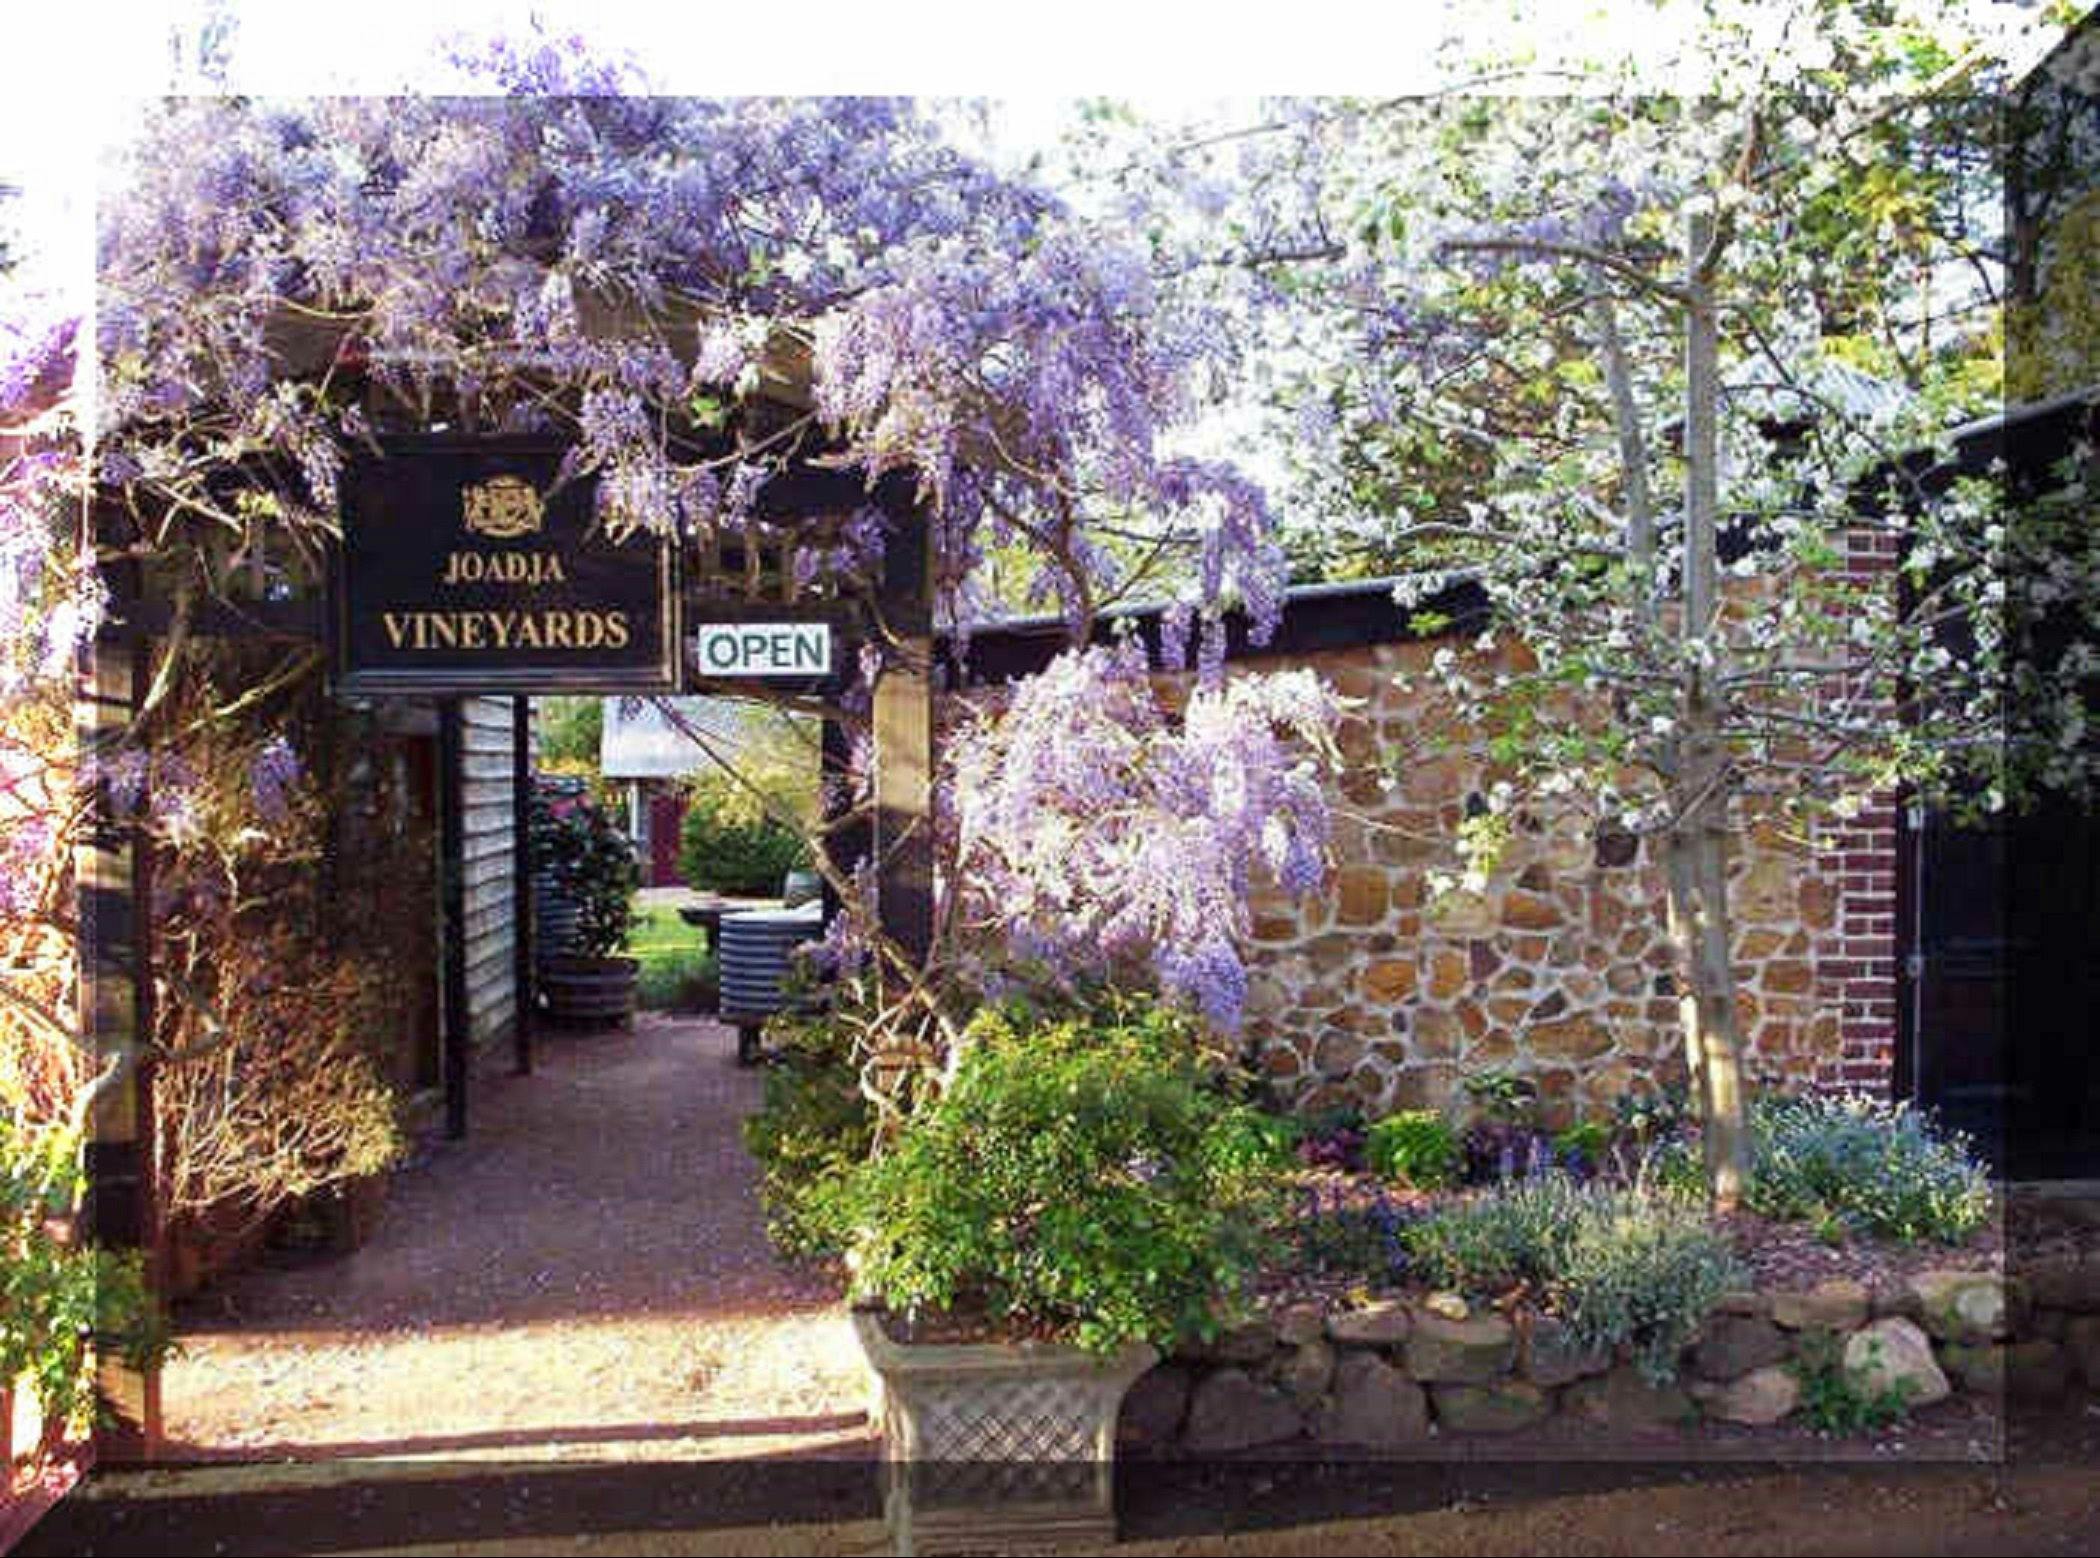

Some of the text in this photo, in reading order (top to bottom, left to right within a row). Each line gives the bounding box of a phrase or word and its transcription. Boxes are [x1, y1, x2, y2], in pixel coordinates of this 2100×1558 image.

[443, 551, 566, 584] JOADJA
[383, 611, 630, 651] VINEYARDS
[706, 632, 825, 669] OPEN
